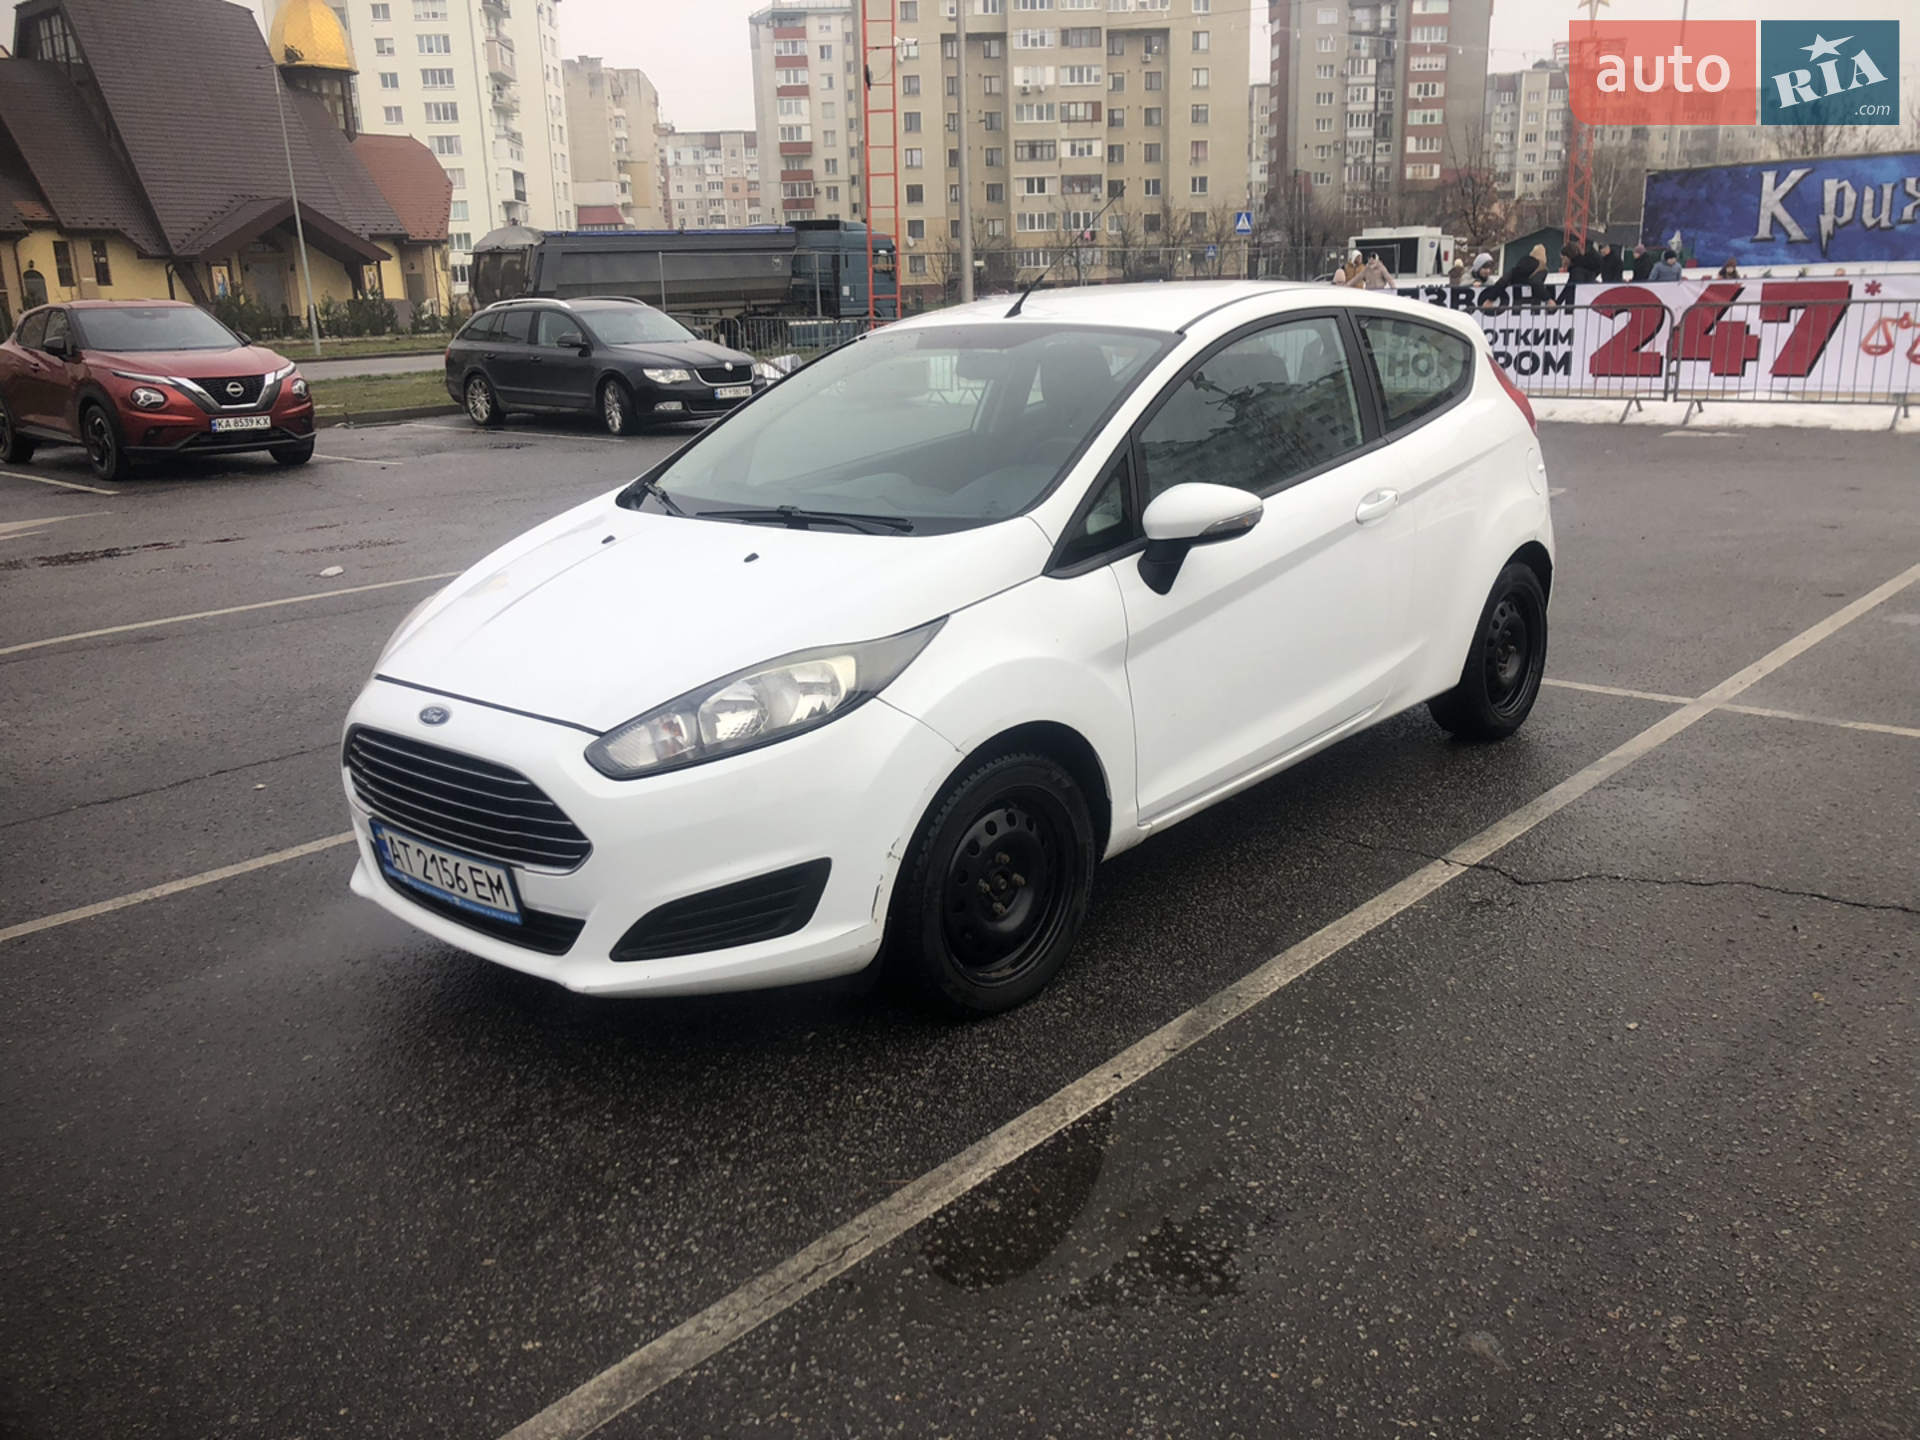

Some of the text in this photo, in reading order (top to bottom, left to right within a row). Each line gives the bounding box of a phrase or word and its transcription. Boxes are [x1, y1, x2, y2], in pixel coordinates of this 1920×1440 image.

[389, 835, 414, 873] AT
[416, 848, 468, 894] 2156
[468, 865, 509, 907] EM
